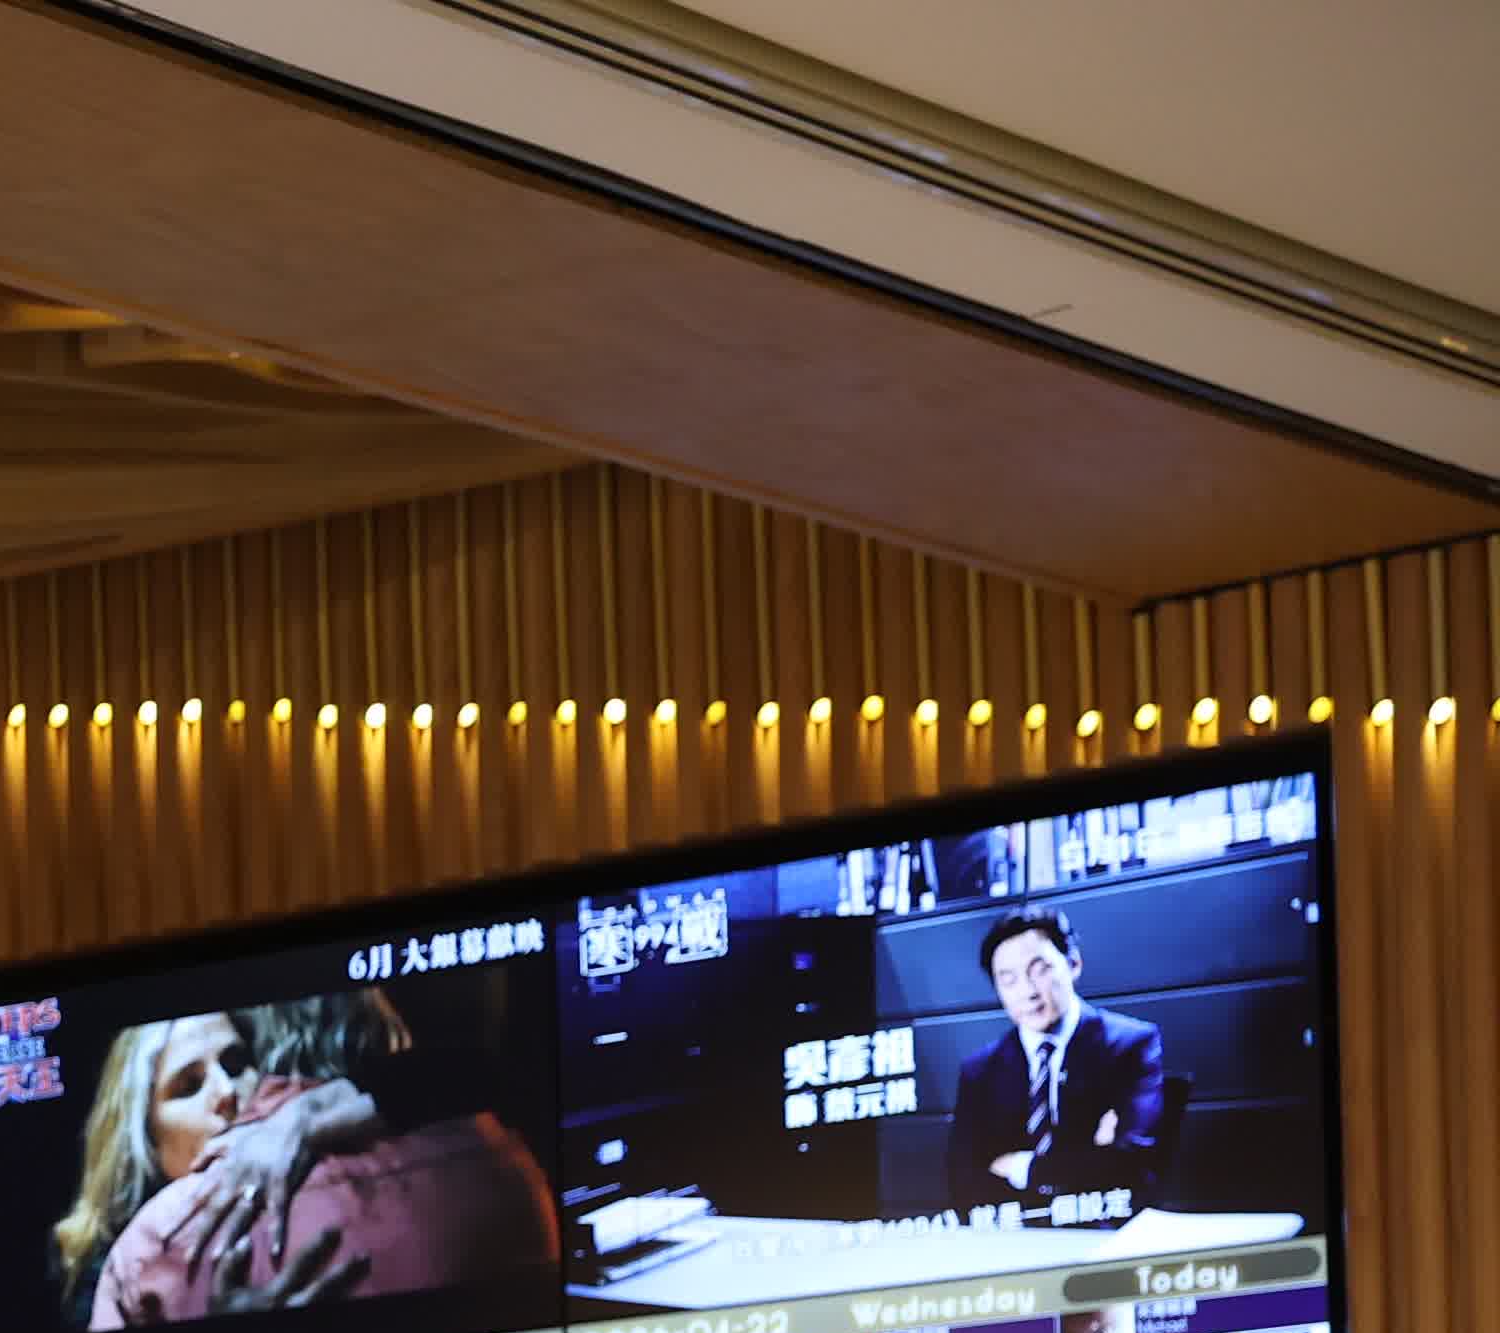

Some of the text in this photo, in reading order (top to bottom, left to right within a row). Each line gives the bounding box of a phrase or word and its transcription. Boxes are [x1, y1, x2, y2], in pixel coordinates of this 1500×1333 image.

[349, 943, 394, 981] 6月
[850, 1287, 1036, 1328] Wednesday
[1135, 1262, 1240, 1295] Today
